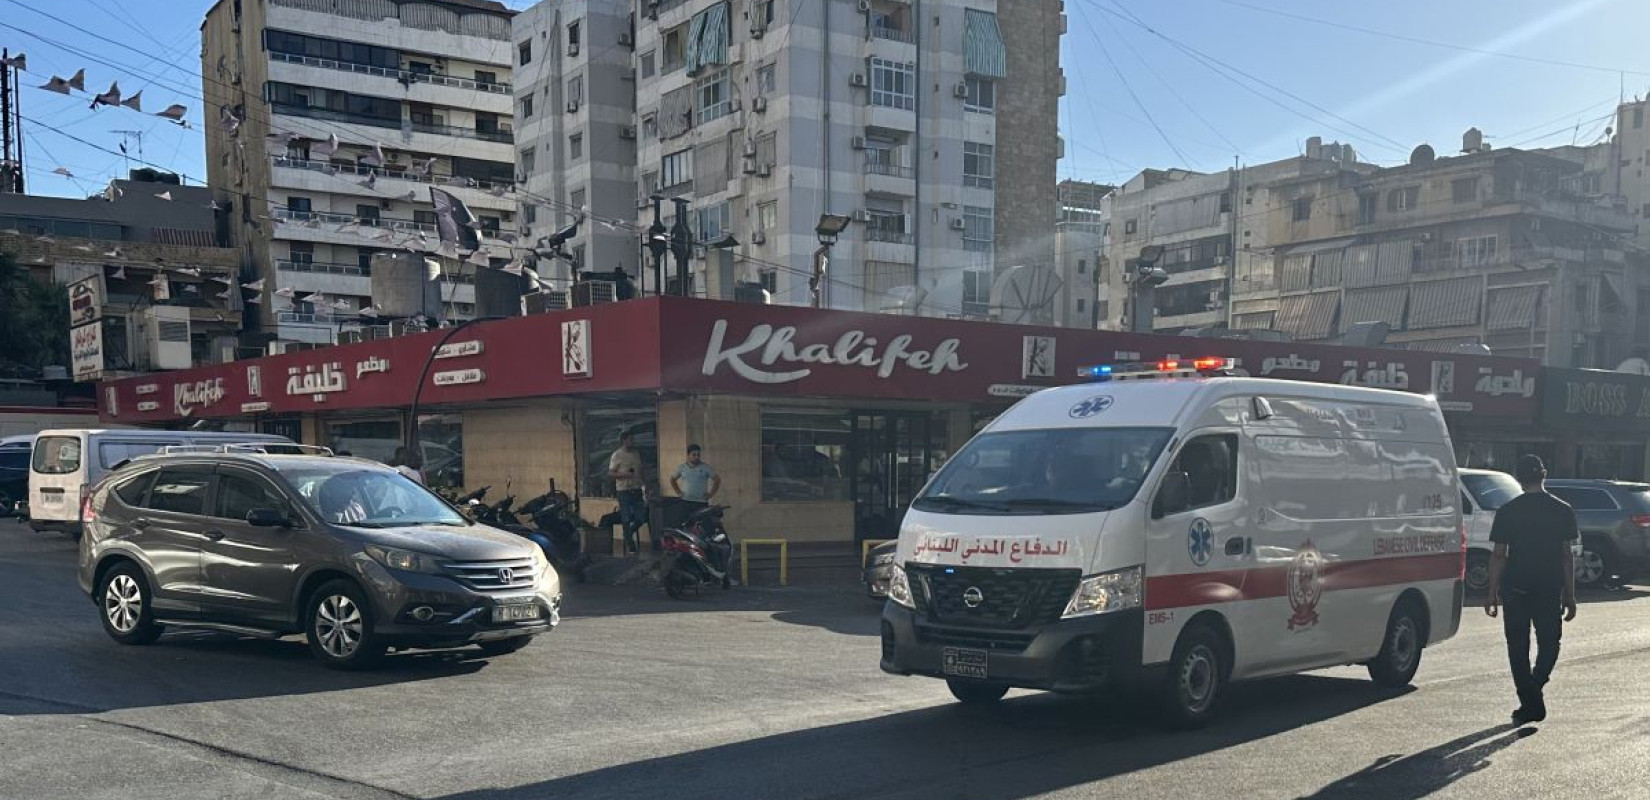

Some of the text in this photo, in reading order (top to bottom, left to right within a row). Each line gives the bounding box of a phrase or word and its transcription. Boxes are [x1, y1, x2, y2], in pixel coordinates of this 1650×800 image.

[702, 319, 968, 384] Khalifeh
[174, 377, 225, 417] Khalifeh
[286, 361, 347, 402] خليفة
[1566, 381, 1627, 417] BOSS
[913, 537, 1068, 564] الدفاع المدني اللبناني
[1373, 537, 1403, 555] LEBANESE
[1149, 611, 1174, 625] EMS-1
